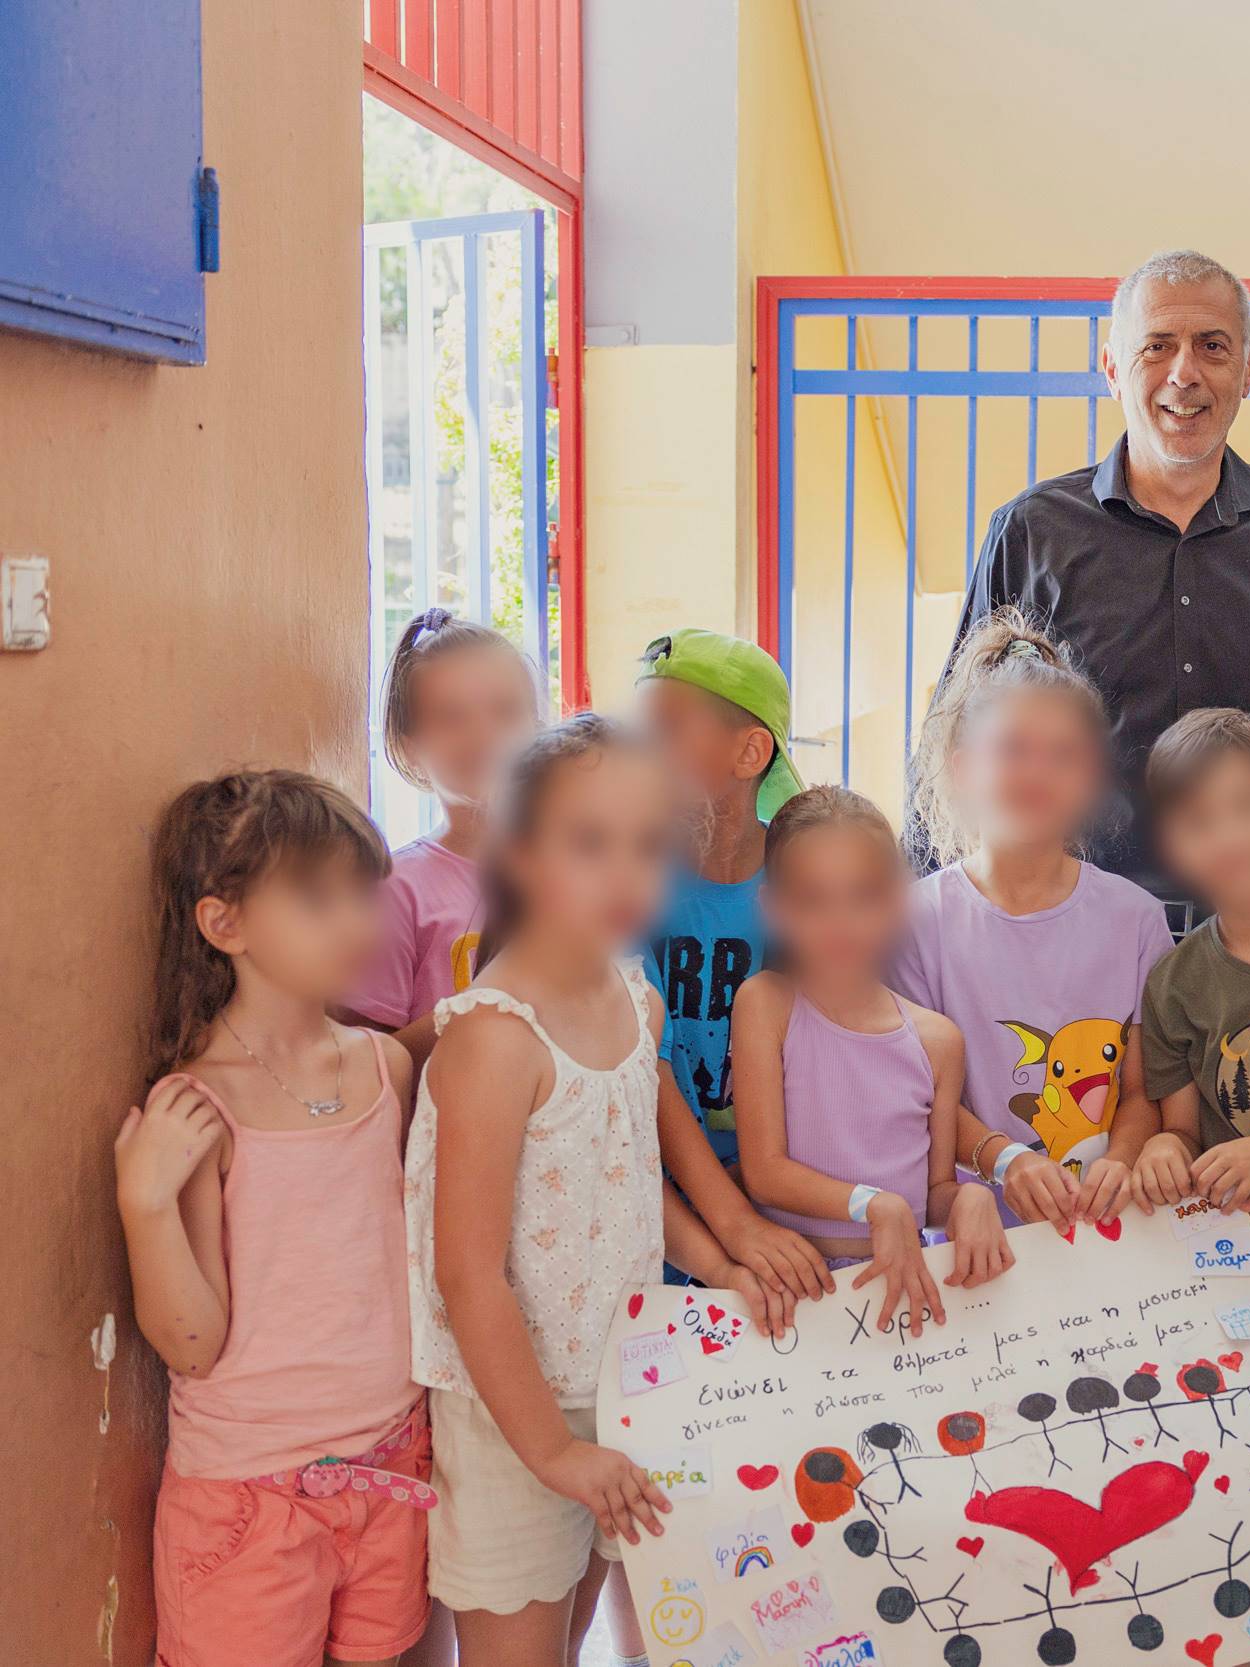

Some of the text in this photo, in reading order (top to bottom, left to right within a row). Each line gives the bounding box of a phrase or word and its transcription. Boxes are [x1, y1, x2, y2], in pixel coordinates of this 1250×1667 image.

[699, 1377, 789, 1406] Ενώνει
[821, 1367, 859, 1381] τα
[993, 1326, 1039, 1364] μας
[1059, 1314, 1093, 1331] και
[1101, 1306, 1120, 1318] η
[1138, 1277, 1208, 1320] μουσική
[682, 1414, 748, 1441] γίνεται
[782, 1407, 794, 1416] η
[970, 1364, 1017, 1392] μιλά
[1037, 1358, 1050, 1367] η
[645, 1460, 707, 1488] αρέα
